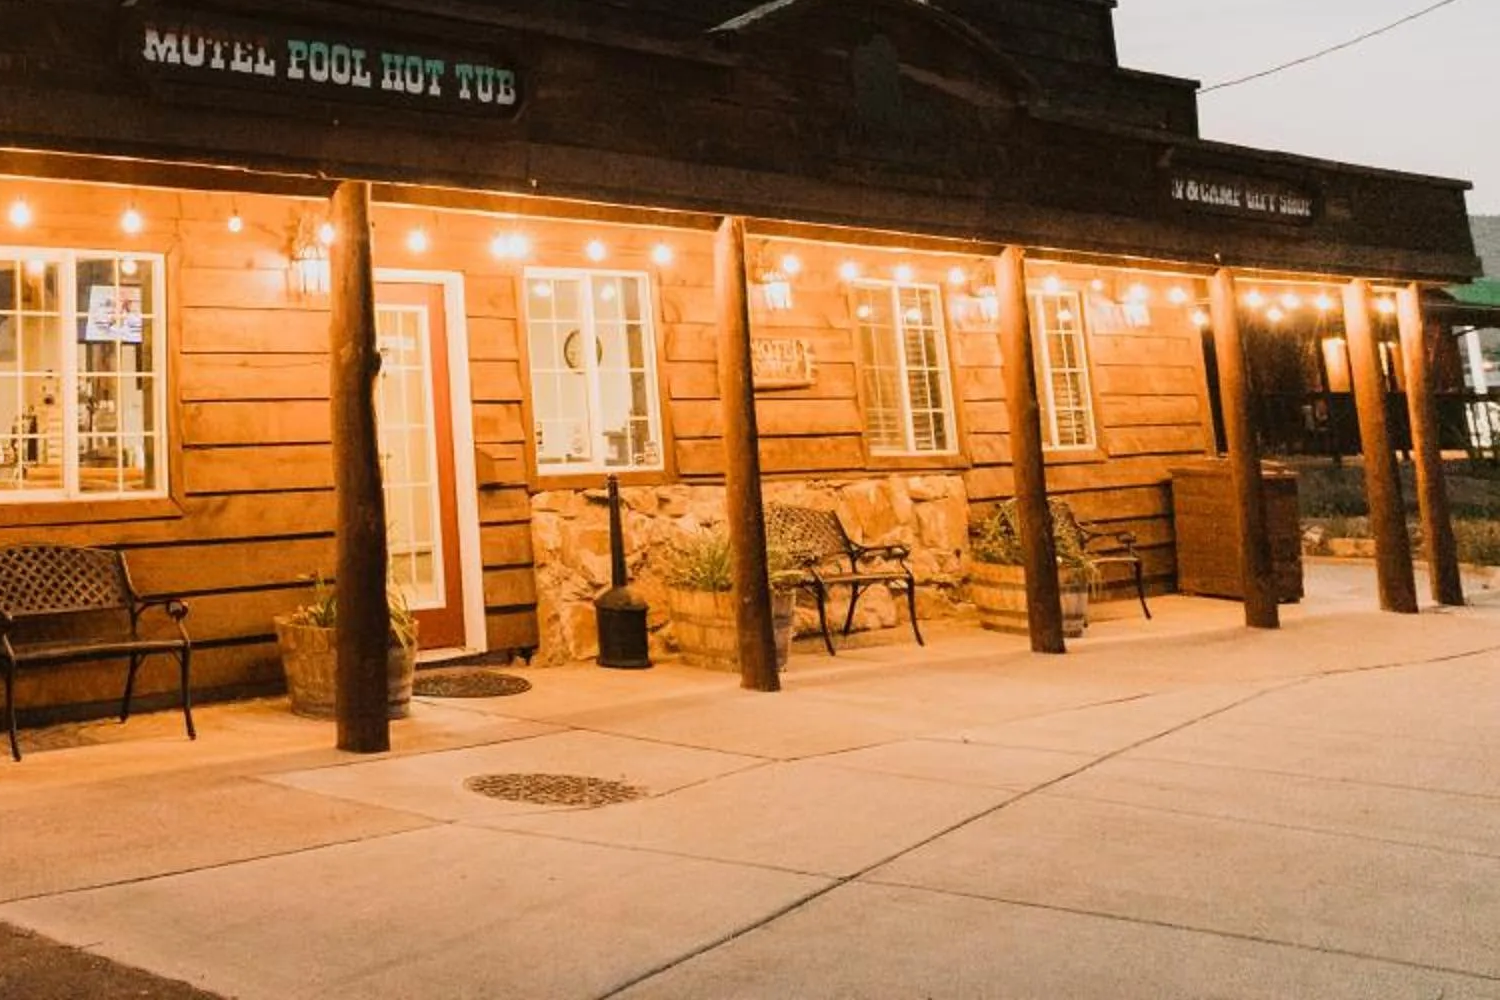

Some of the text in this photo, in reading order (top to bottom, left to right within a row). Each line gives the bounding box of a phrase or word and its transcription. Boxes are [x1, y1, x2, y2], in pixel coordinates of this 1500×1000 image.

[142, 26, 515, 105] MOTEL POOL HOT TUB
